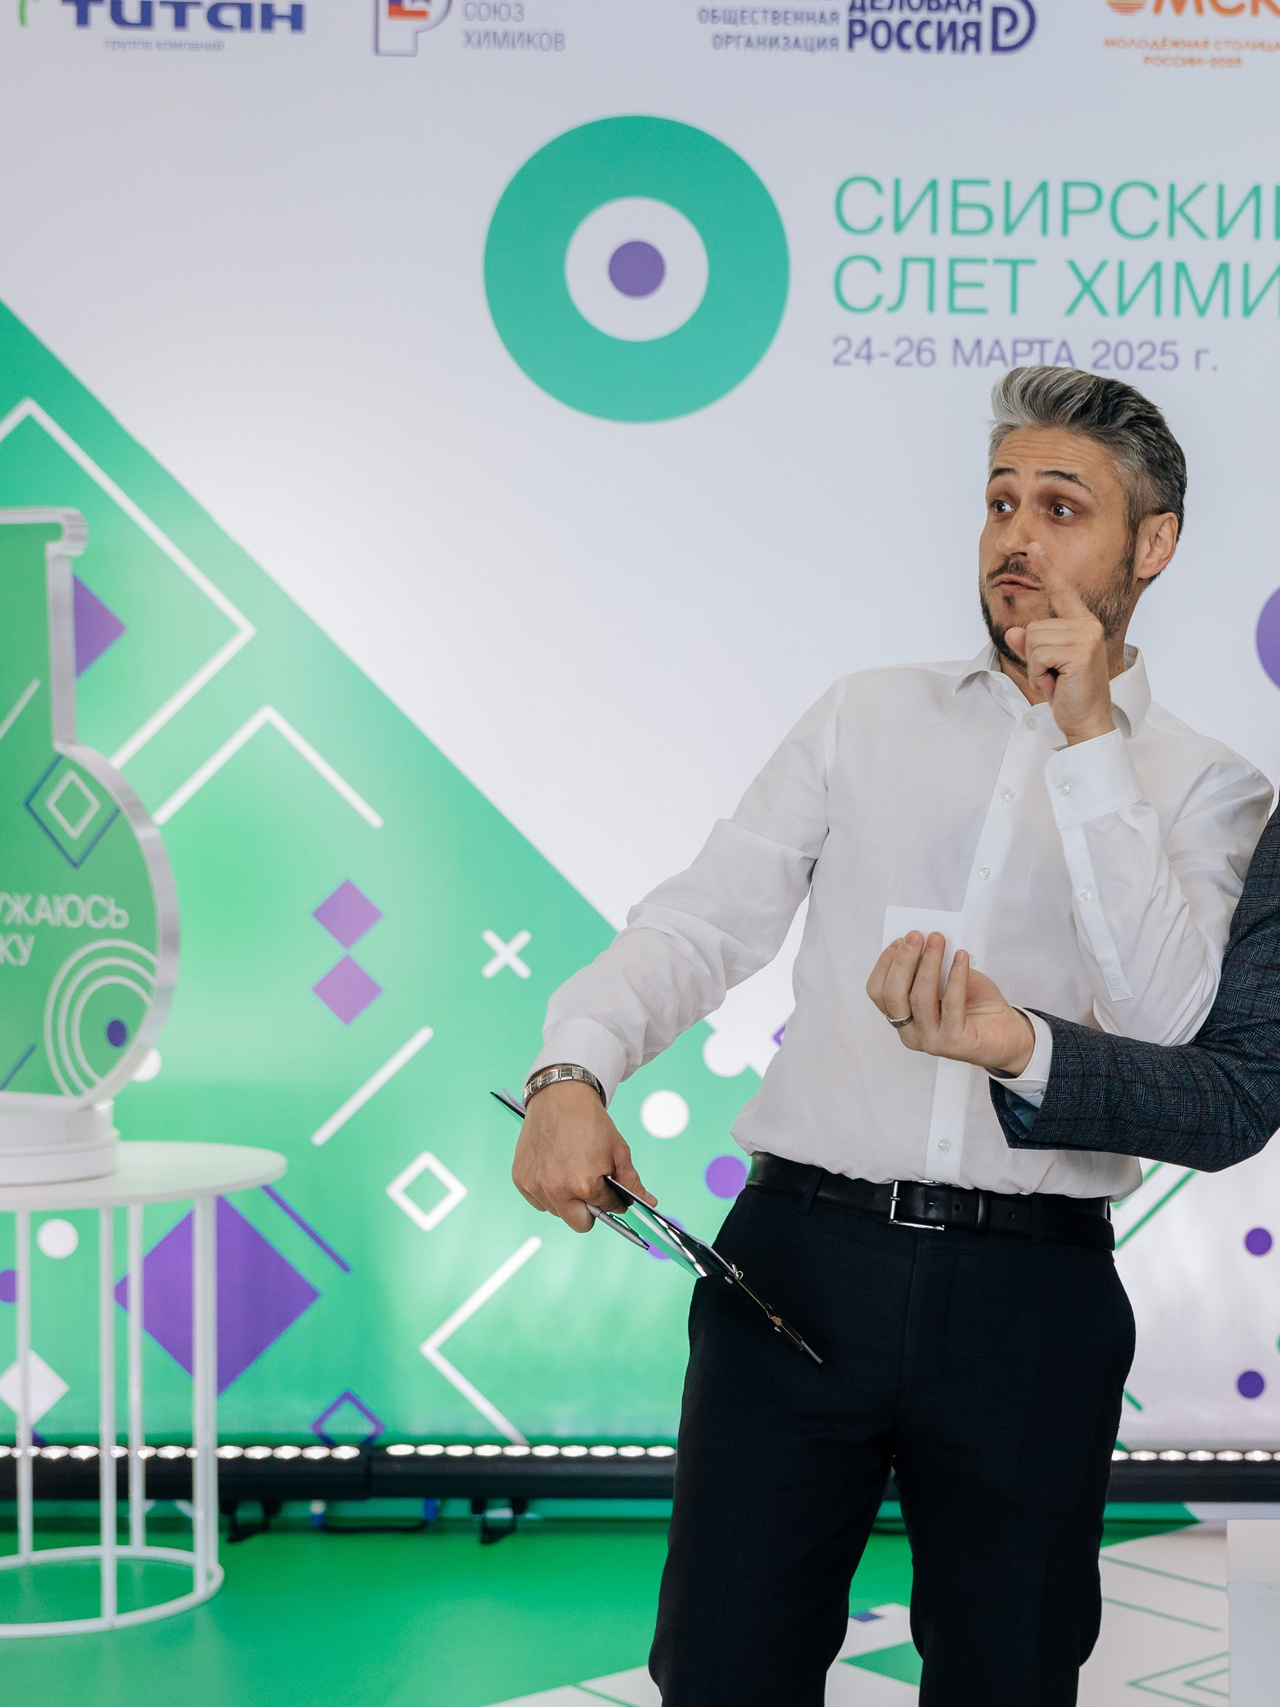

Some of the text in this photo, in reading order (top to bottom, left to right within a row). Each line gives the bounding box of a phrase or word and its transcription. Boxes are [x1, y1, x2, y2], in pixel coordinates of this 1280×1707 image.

[463, 1, 526, 22] СОЮЗ
[698, 8, 840, 27] ОБЩЕСТВЕННАЯ
[463, 30, 566, 51] ХИМИКОВ
[712, 34, 840, 54] ОРГАНИЗАЦИЯ
[848, 19, 982, 52] РОССИЯ
[832, 253, 1037, 315] СЛЕТ
[831, 335, 1219, 372] 24-26 МАРТА 2025 г.
